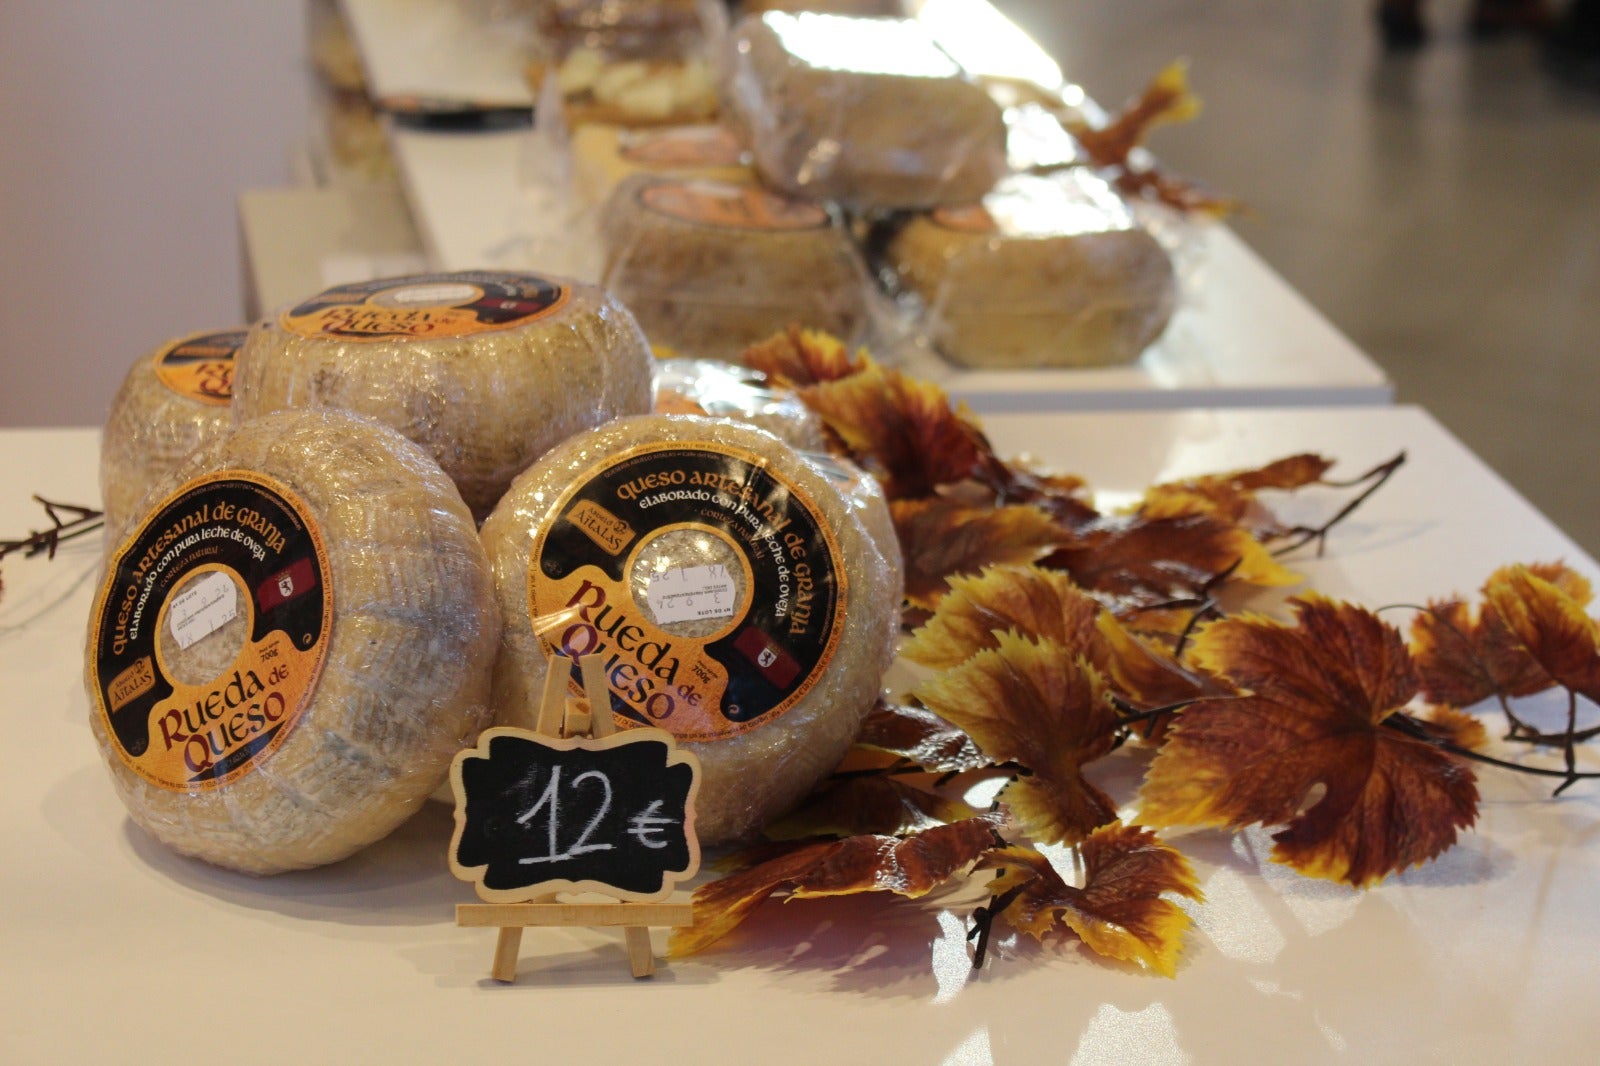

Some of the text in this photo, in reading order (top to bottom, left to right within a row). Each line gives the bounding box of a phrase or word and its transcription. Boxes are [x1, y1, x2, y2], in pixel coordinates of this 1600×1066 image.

[565, 579, 680, 686] Rueda
[157, 669, 266, 751] Rueda
[268, 663, 290, 686] de
[184, 691, 286, 773] Queso
[677, 683, 702, 707] de
[515, 765, 680, 865] 12 €
